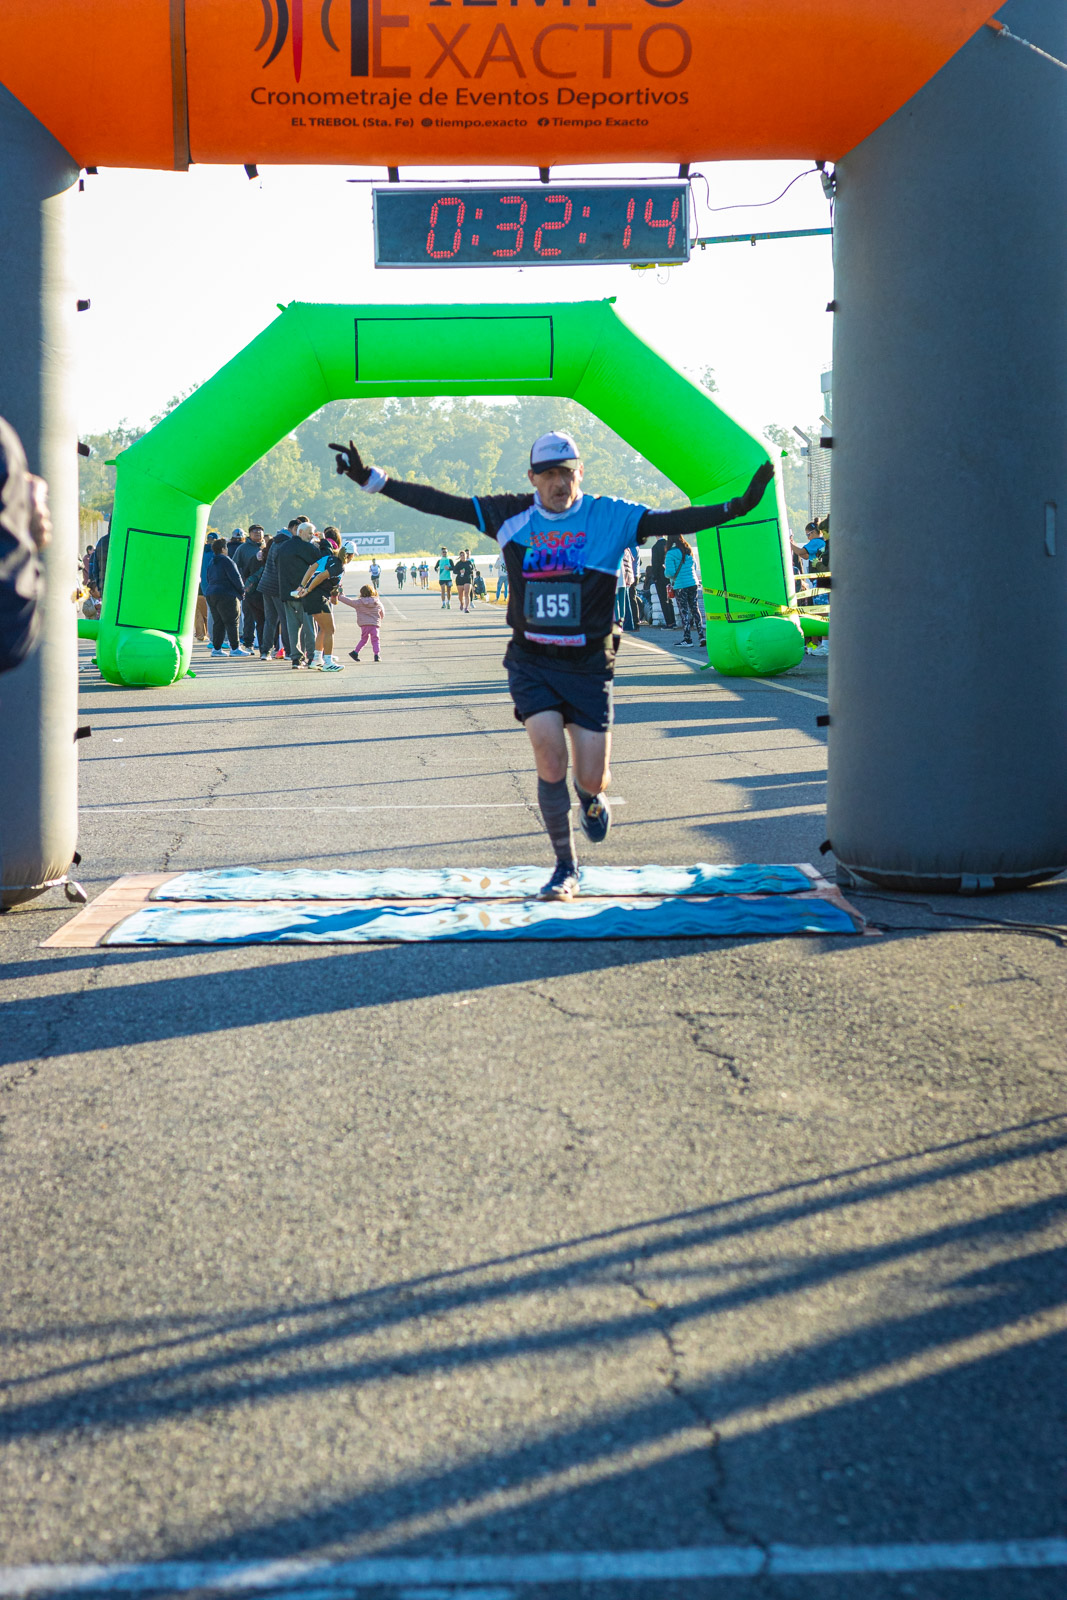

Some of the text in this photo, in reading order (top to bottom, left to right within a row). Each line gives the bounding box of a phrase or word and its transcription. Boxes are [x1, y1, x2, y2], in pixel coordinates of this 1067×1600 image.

[372, 0, 692, 79] EXACTO
[251, 86, 689, 110] Cronometraje de Eventos Deportivos
[291, 117, 306, 127] EL
[308, 117, 359, 127] TREBOL
[362, 117, 391, 128] (Sta.
[395, 117, 414, 128] Fe)
[553, 117, 602, 128] Tiempo
[605, 117, 649, 127] Exacto
[536, 594, 570, 618] 155
